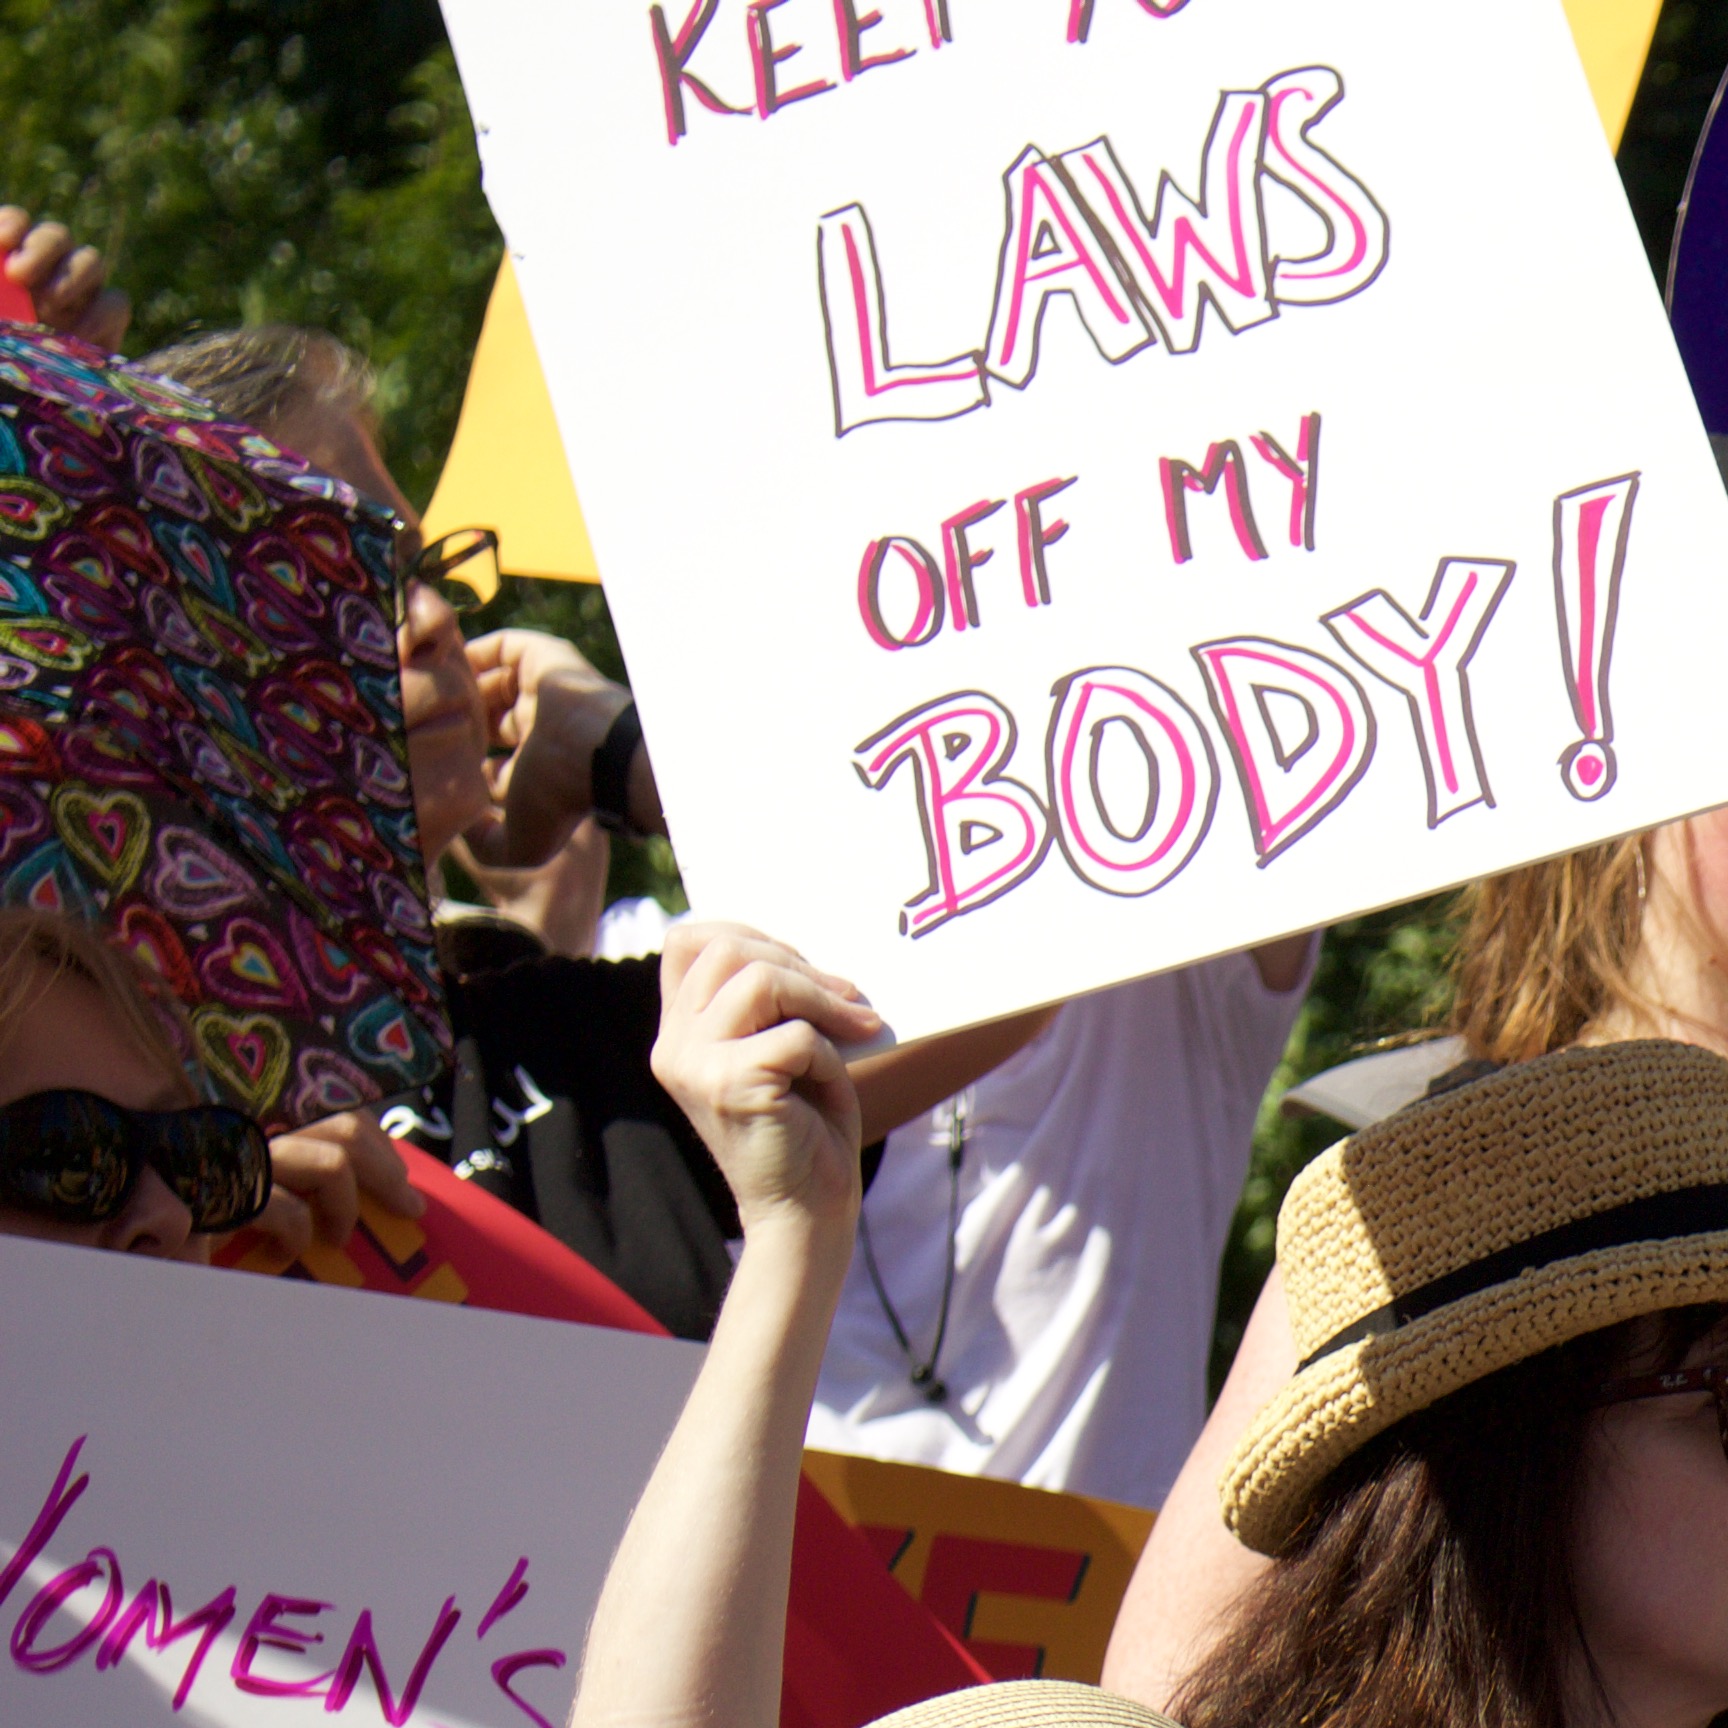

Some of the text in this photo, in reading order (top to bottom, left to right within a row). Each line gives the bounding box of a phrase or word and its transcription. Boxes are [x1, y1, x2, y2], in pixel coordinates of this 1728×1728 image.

[818, 66, 1390, 438] LAWS
[852, 472, 1640, 937] BODY!
[858, 411, 1321, 650] OFF MY
